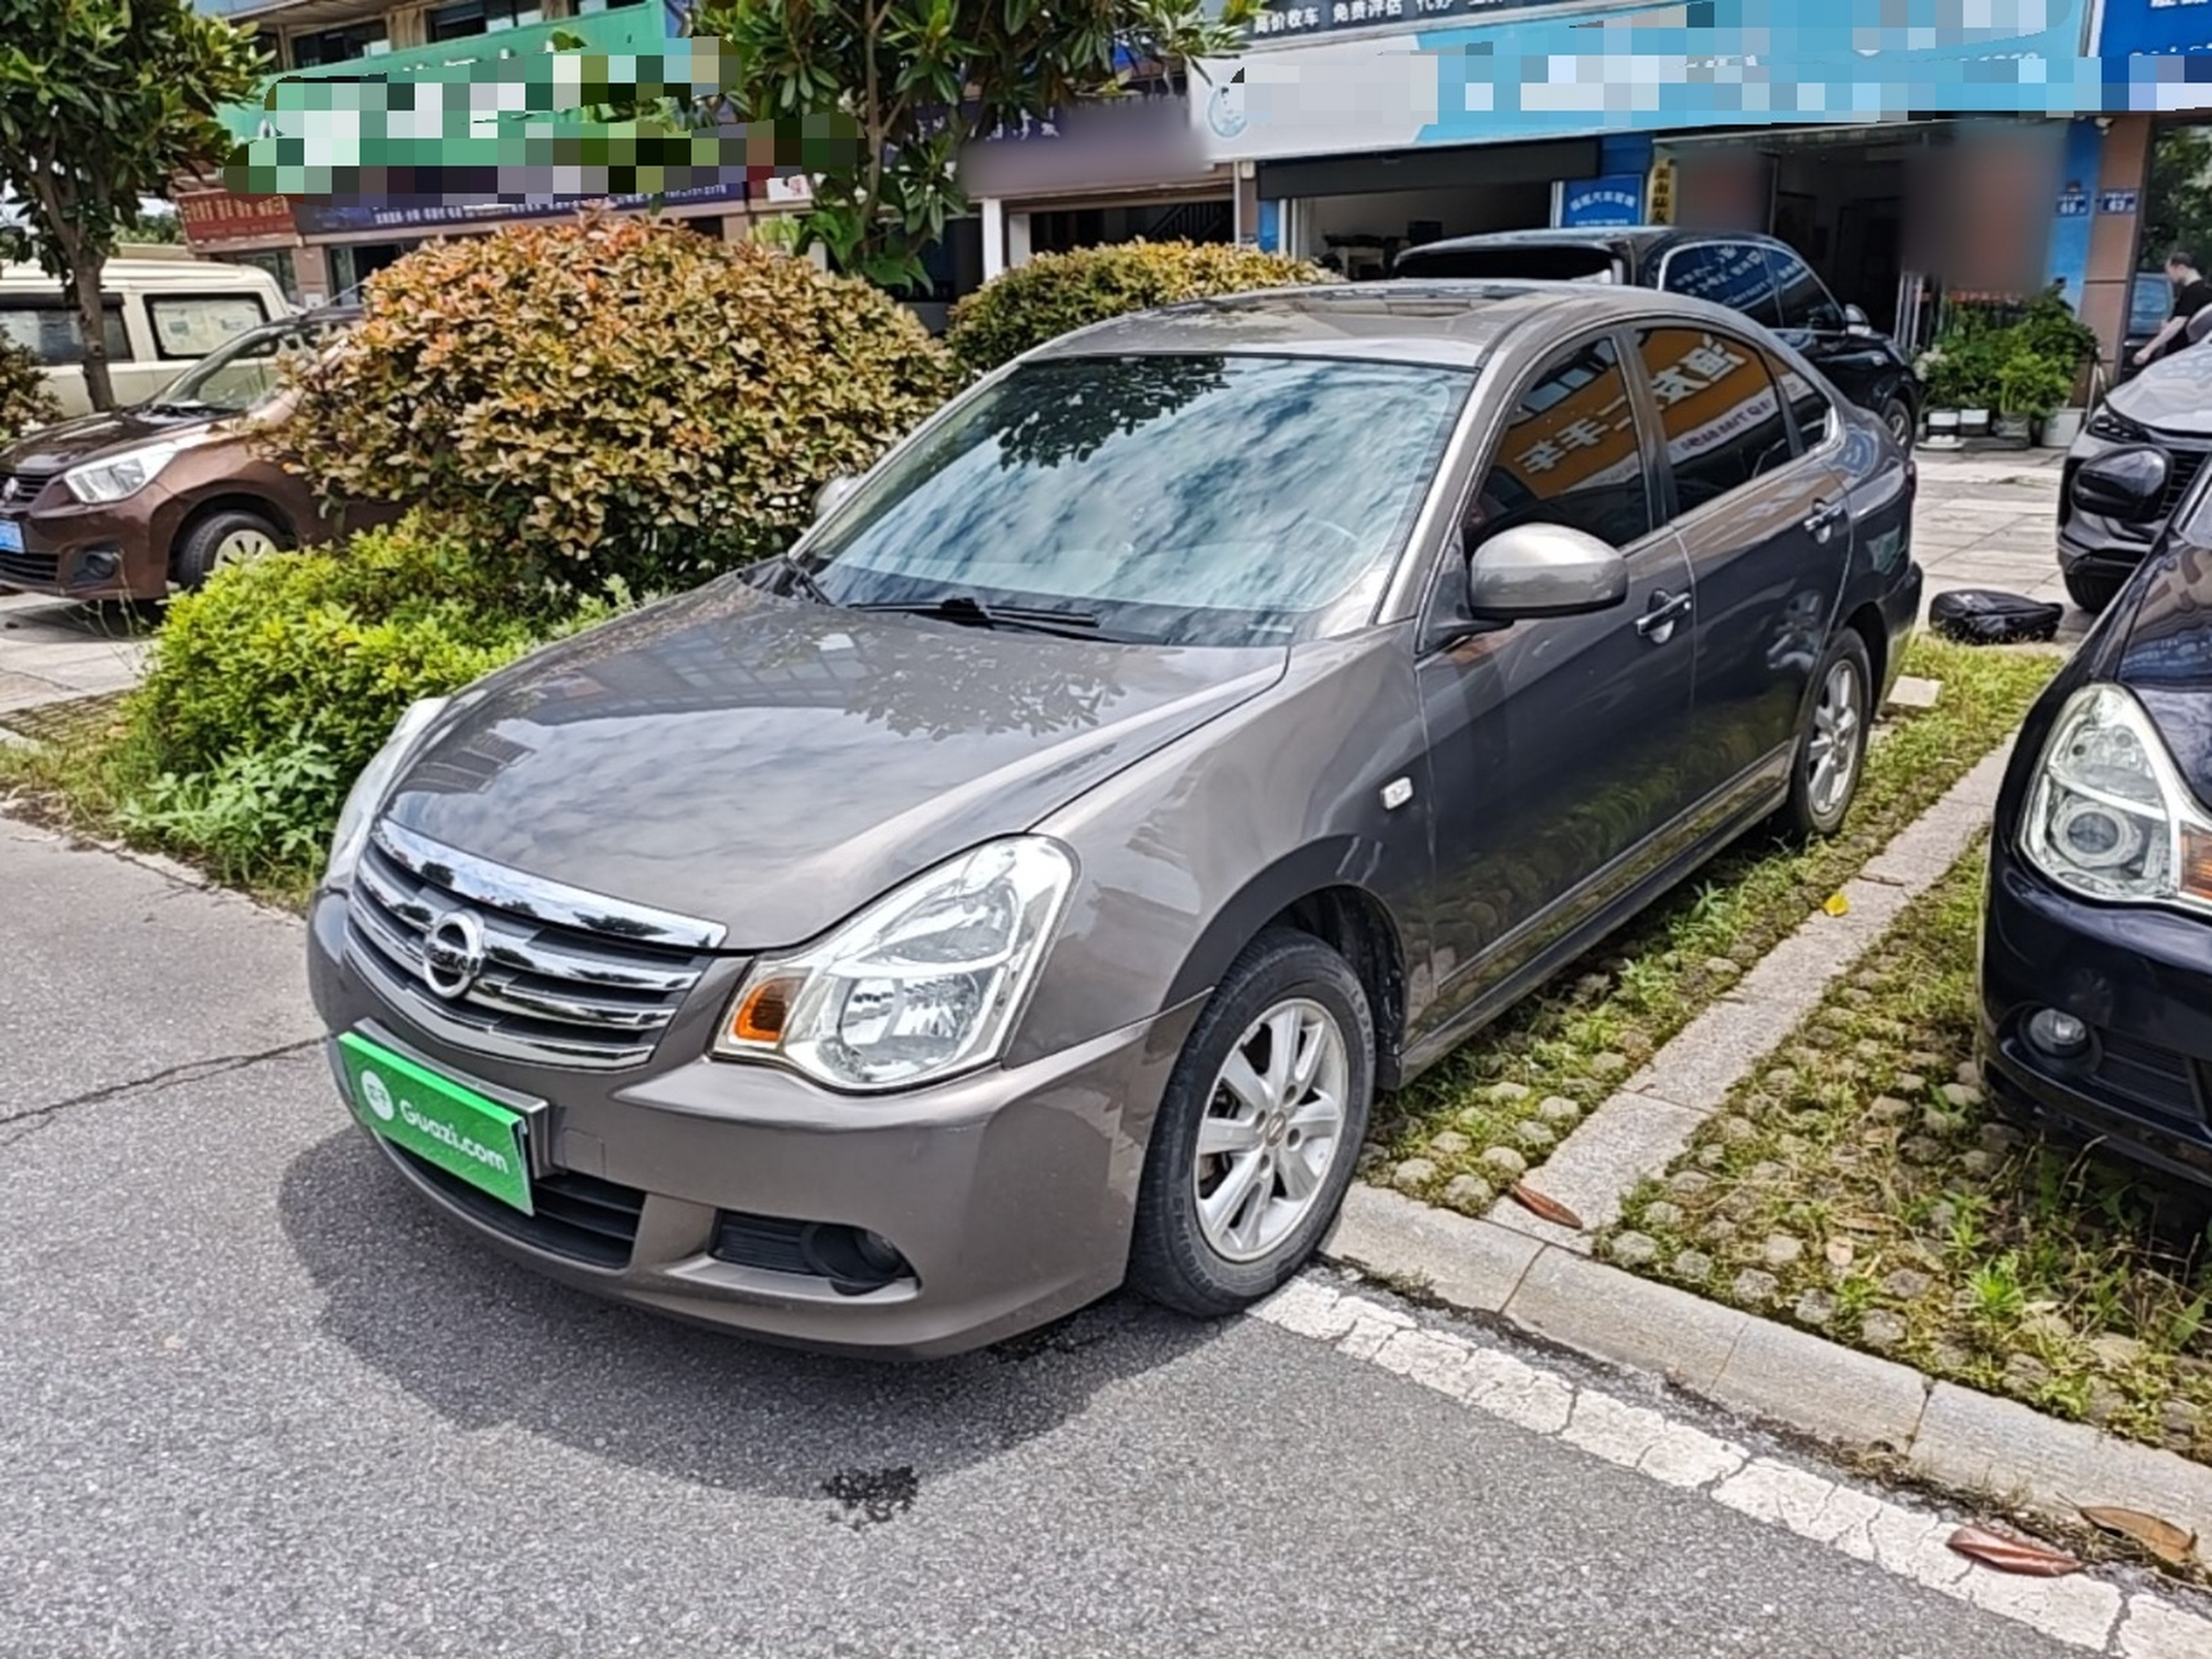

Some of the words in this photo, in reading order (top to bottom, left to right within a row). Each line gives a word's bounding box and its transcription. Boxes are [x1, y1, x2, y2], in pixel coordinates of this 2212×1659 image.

[1253, 7, 1319, 33] 高价收车
[1332, 0, 1402, 24] 免费评估
[400, 1099, 509, 1175] Guazi.com
